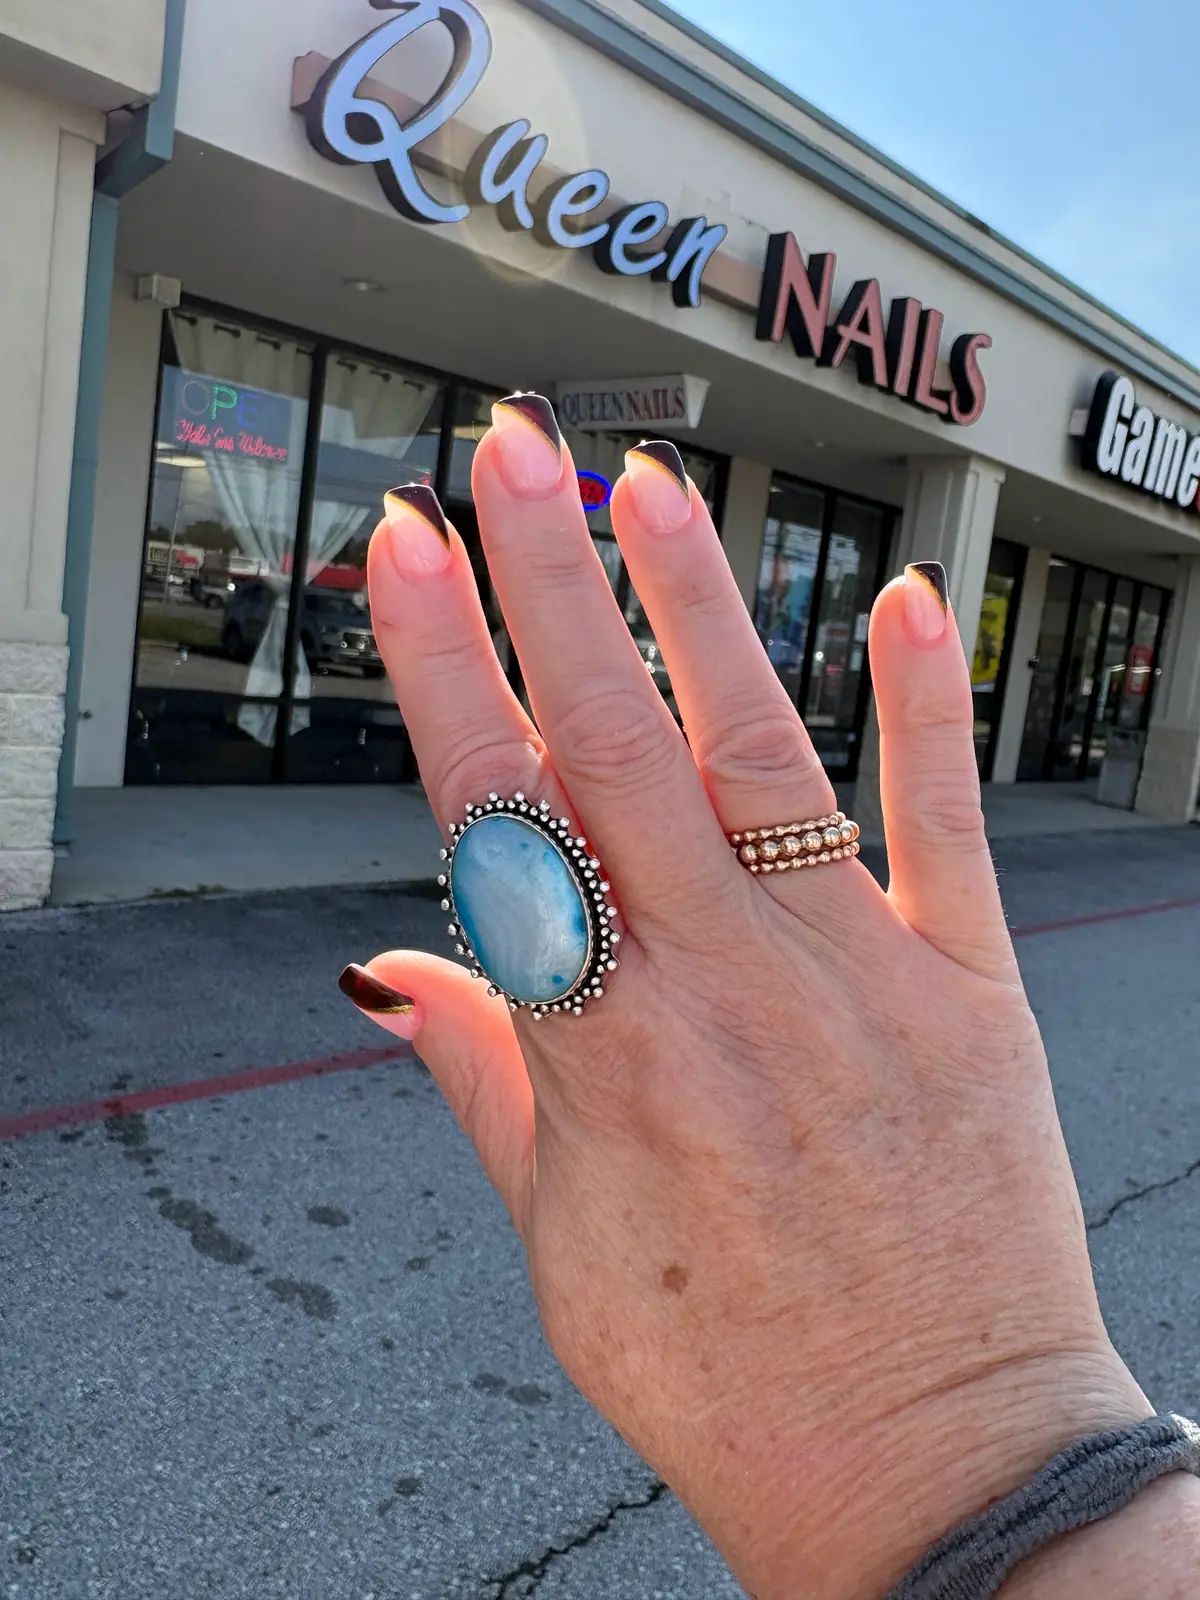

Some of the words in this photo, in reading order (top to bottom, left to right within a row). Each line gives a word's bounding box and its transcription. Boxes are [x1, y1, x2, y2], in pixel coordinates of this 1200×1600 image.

[314, 0, 728, 309] Queen
[762, 231, 992, 426] NAILS
[563, 391, 625, 426] QUEEN
[626, 386, 685, 421] NAILS
[1096, 376, 1200, 507] Game
